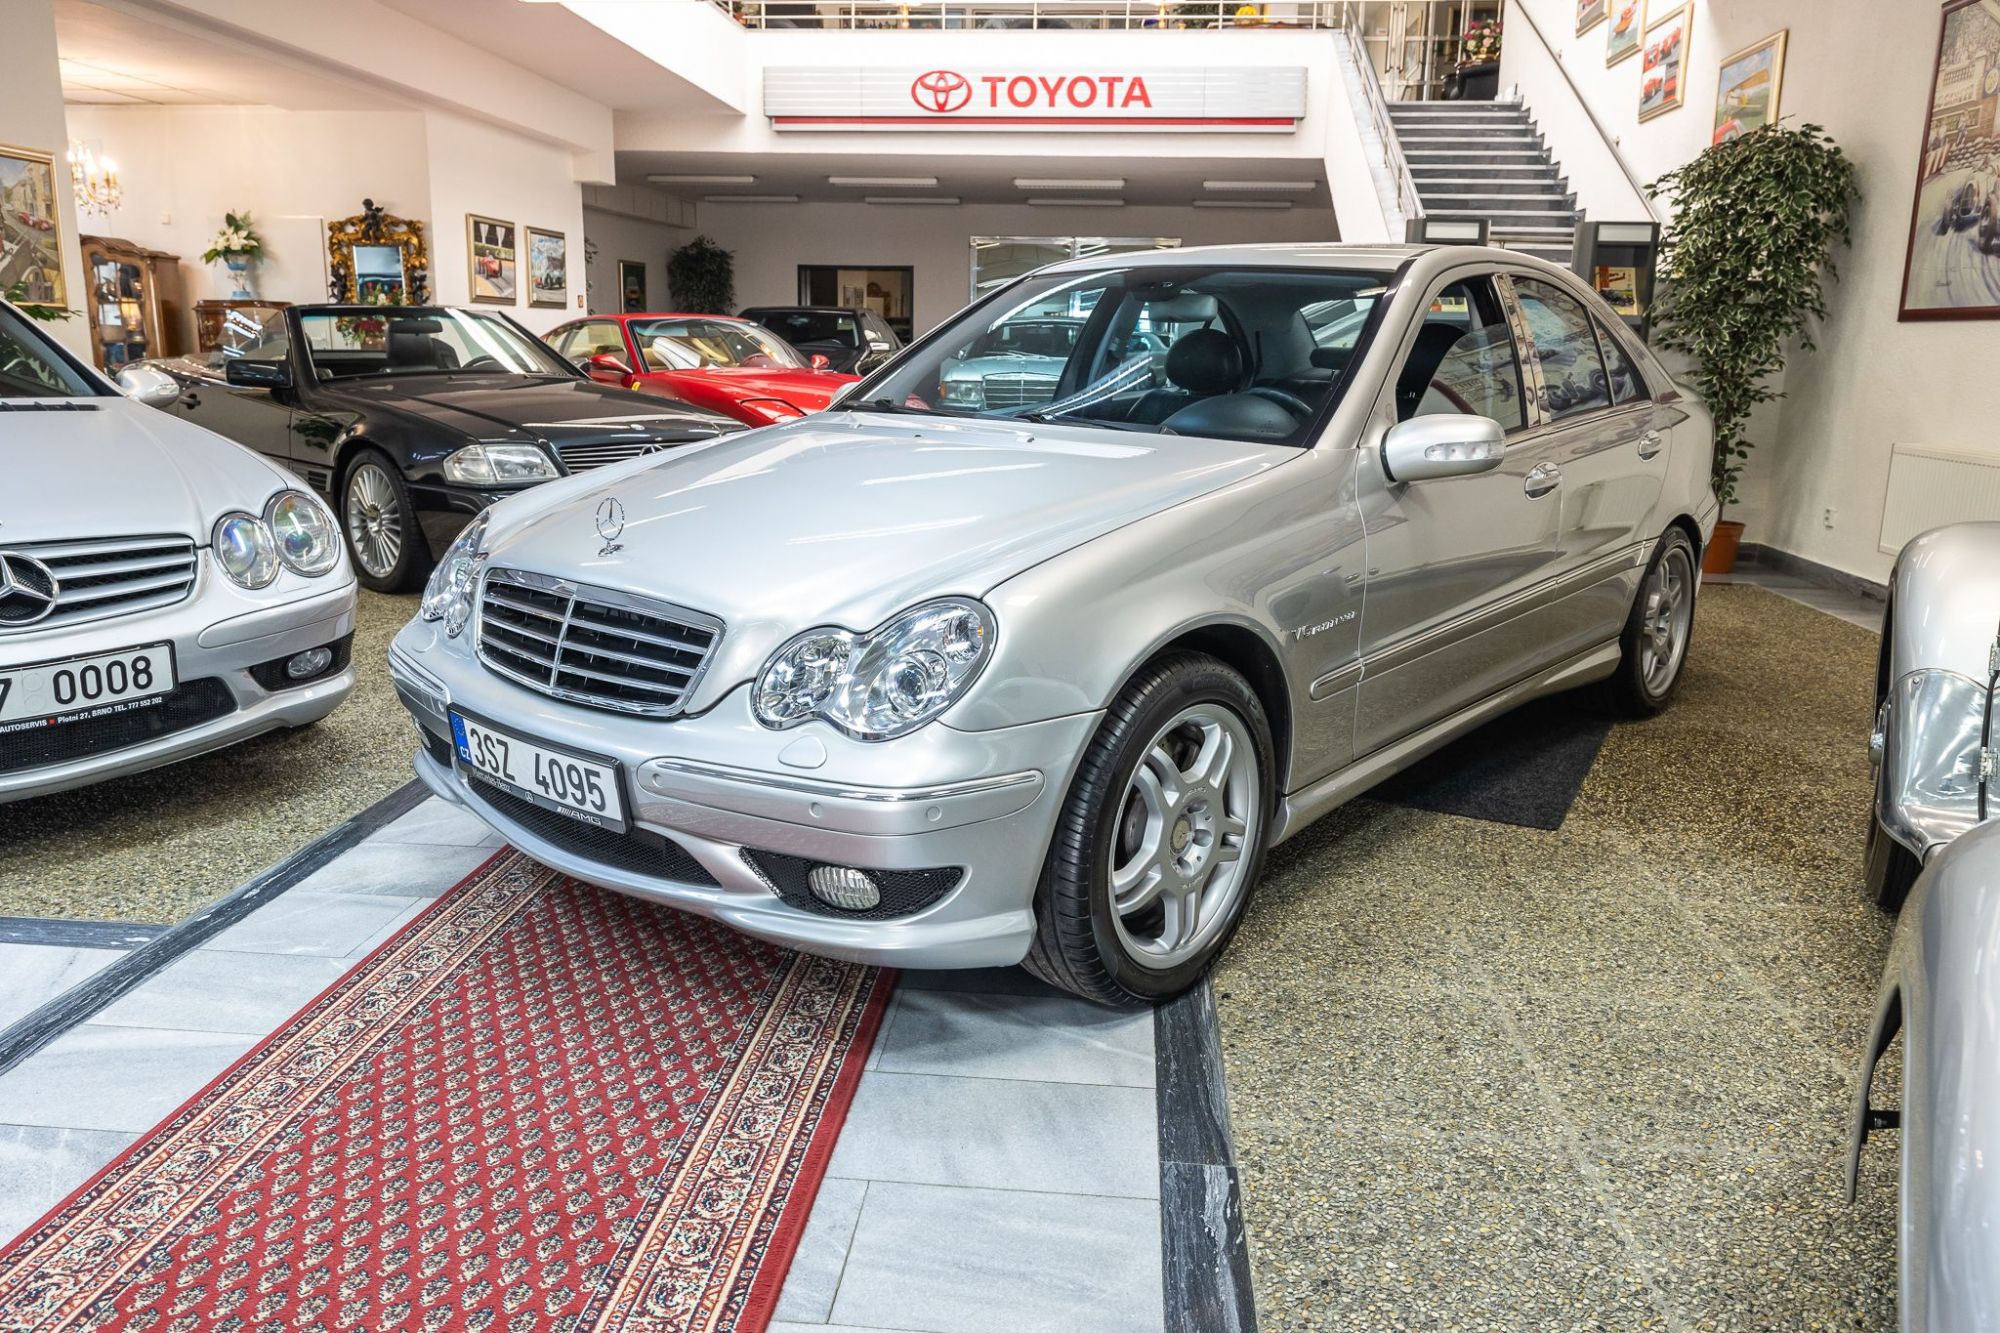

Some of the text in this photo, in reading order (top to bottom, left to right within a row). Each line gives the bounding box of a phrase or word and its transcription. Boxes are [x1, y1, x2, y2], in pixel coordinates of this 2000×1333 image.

[981, 76, 1152, 108] TOYOTA
[52, 655, 153, 705] 0008
[92, 707, 113, 717] BRNO
[128, 701, 139, 709] 777
[460, 745, 471, 761] CZ
[470, 728, 606, 812] 3SZ 4095
[567, 809, 601, 825] AMG
